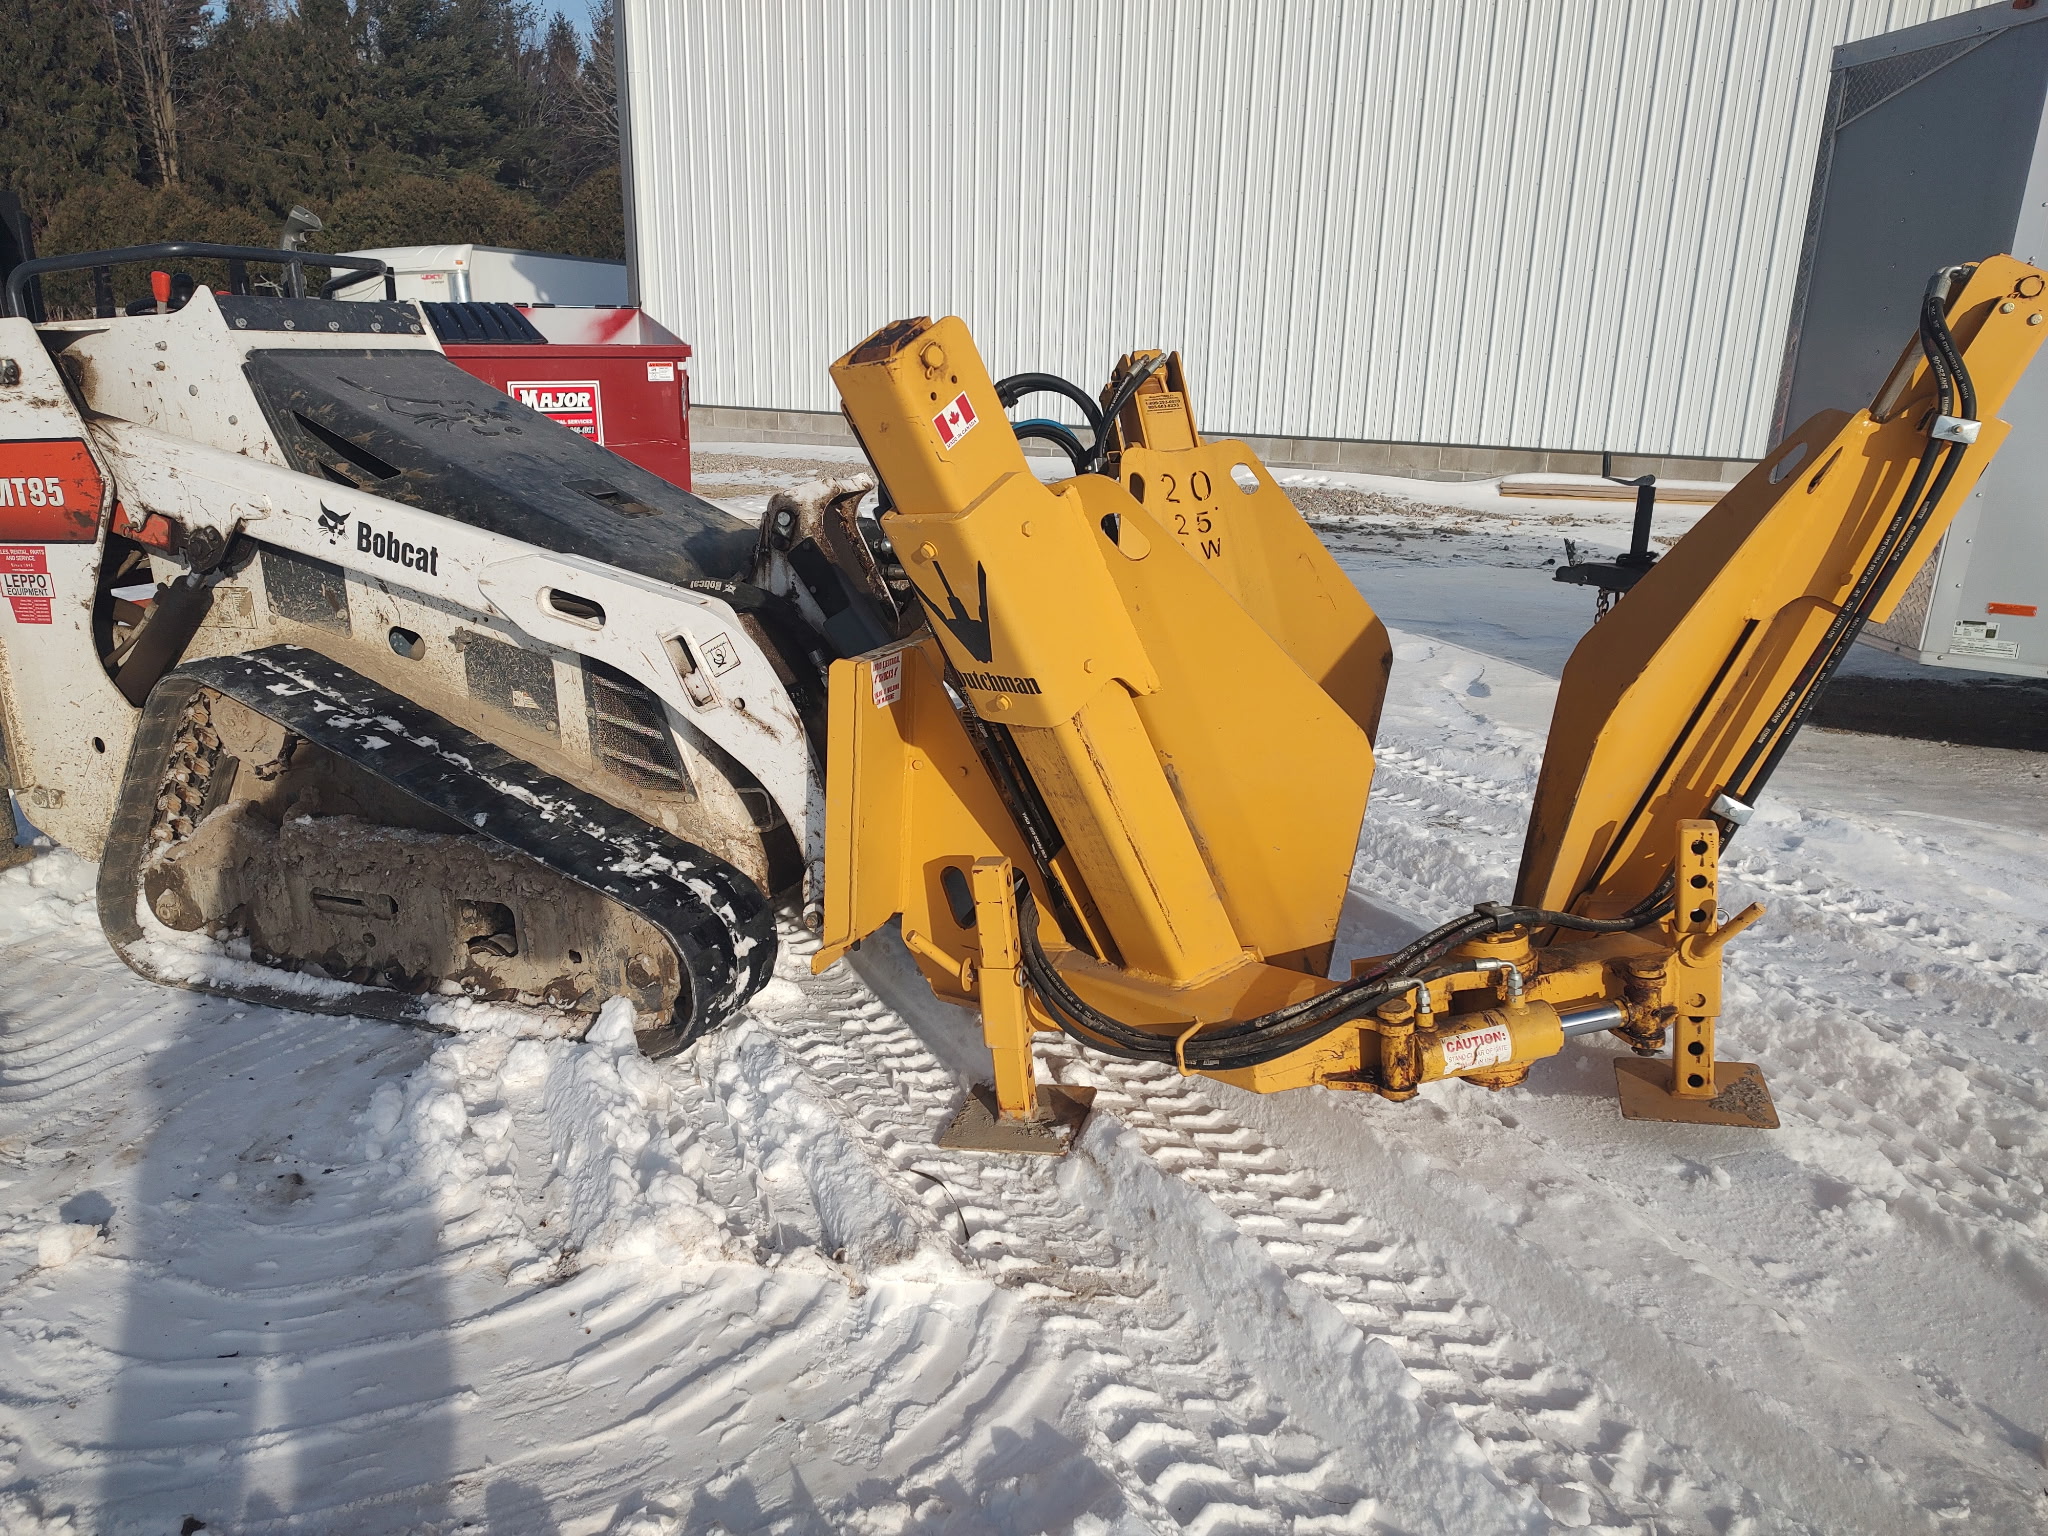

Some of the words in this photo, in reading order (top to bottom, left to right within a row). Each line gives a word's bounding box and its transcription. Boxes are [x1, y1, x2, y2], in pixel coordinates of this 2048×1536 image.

[520, 390, 591, 412] MAJOR
[962, 420, 977, 434] CANADA
[357, 520, 438, 576] Bobcat
[4, 574, 46, 588] LEPPO
[690, 580, 722, 590] Bobcat
[7, 588, 48, 596] EQUIPMENT
[1446, 1032, 1506, 1052] CAUTION:
[1448, 1054, 1466, 1062] STAND
